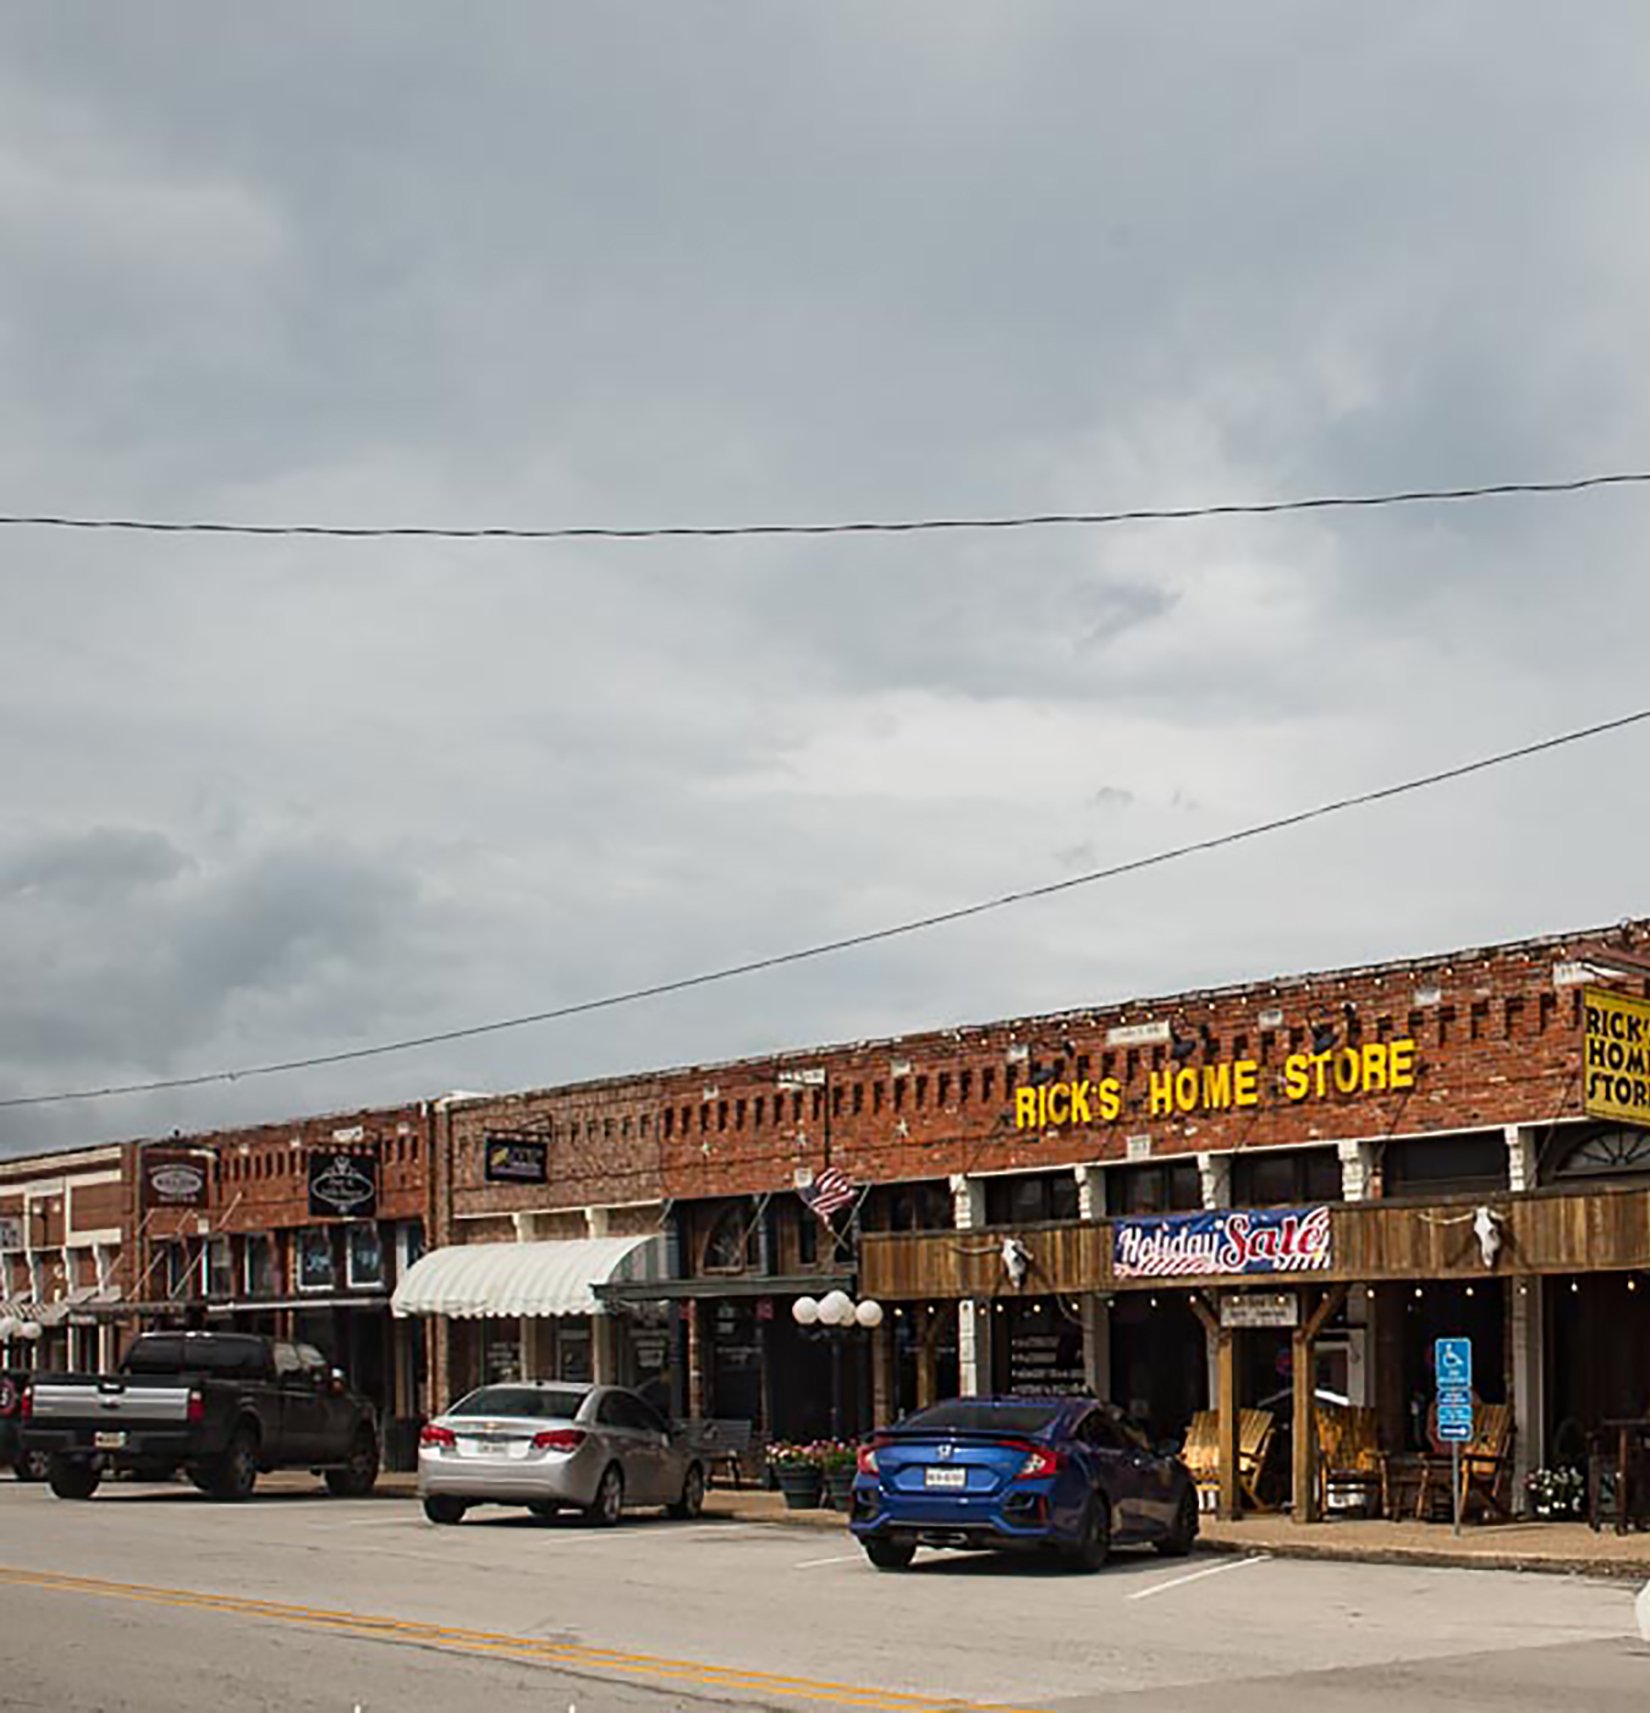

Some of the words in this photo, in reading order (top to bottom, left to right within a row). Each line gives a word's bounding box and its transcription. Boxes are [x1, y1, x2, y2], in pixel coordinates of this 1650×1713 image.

[1015, 1077, 1121, 1129] RICK'S
[1150, 1058, 1259, 1115] HOME
[1284, 1040, 1416, 1099] STORE
[1117, 1223, 1220, 1266] Holiday
[1220, 1211, 1330, 1273] Sale
